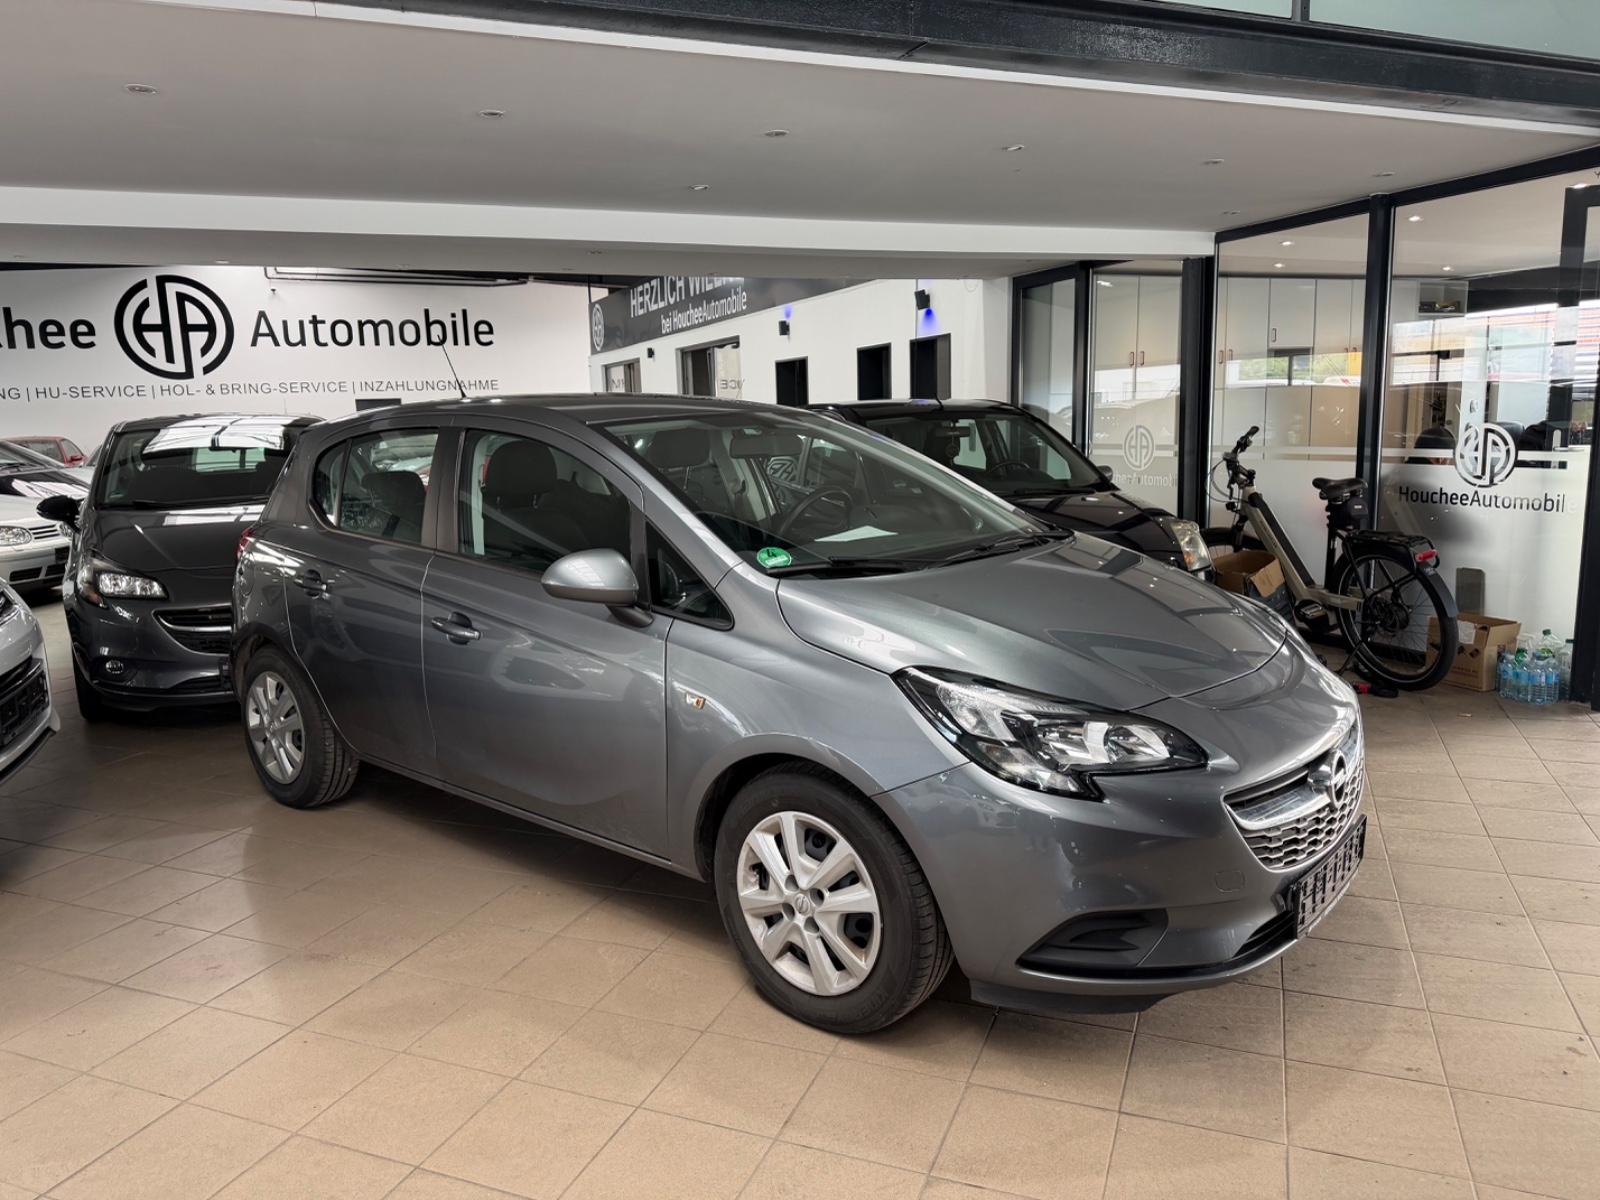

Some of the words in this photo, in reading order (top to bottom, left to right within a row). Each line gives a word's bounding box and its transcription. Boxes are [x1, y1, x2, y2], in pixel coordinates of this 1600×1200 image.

[630, 276, 685, 318] HERZLICH
[0, 307, 97, 350] hee
[250, 308, 494, 347] Automobile
[661, 312, 672, 334] bei
[35, 384, 147, 400] HU-SERVICE
[160, 384, 201, 396] HOL-
[205, 384, 216, 395] &
[220, 381, 348, 395] BRING-SERVICE
[360, 379, 500, 392] INZAHLUNGNAHME
